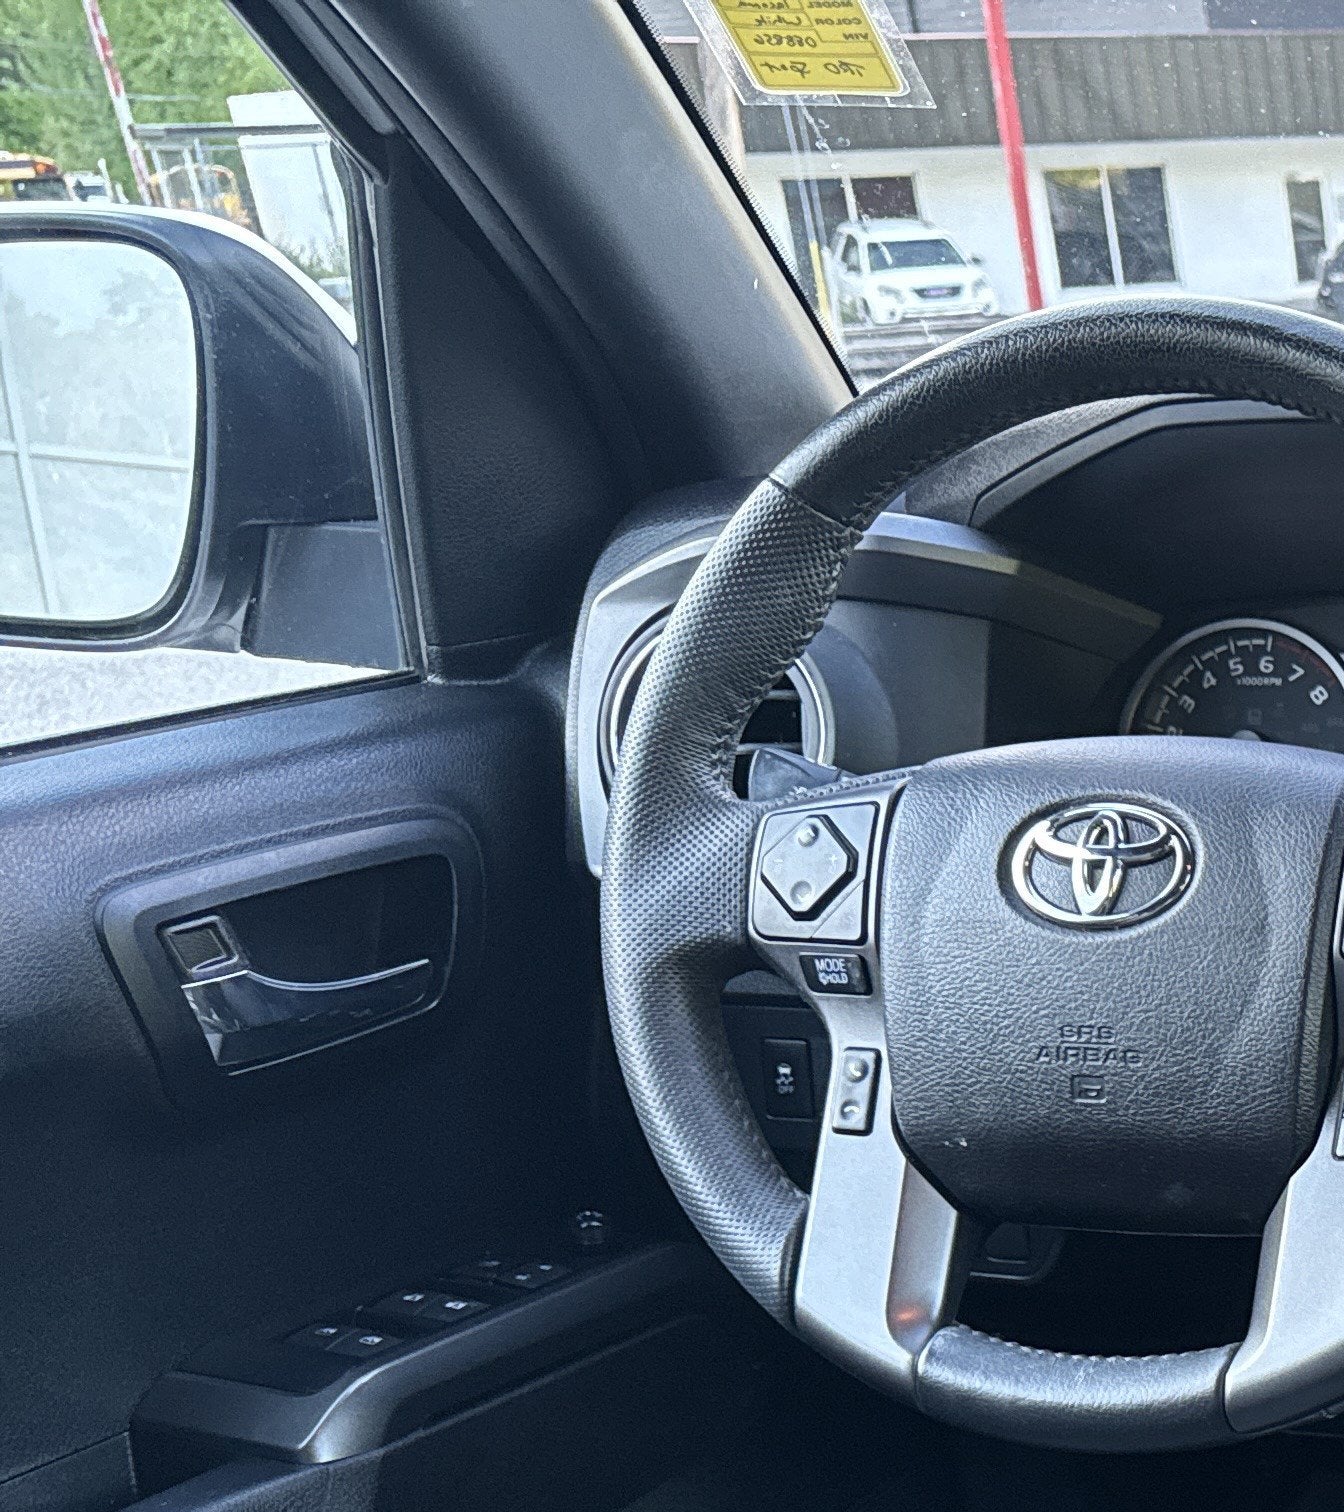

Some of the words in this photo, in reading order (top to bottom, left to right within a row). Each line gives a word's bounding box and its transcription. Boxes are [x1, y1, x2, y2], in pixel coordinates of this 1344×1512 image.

[1228, 656, 1244, 676] 5
[1259, 655, 1275, 673] 6
[1288, 663, 1306, 682] 7
[1202, 671, 1217, 689] 4
[1309, 684, 1330, 705] 8
[1178, 695, 1196, 714] 3
[814, 958, 847, 972] MODE
